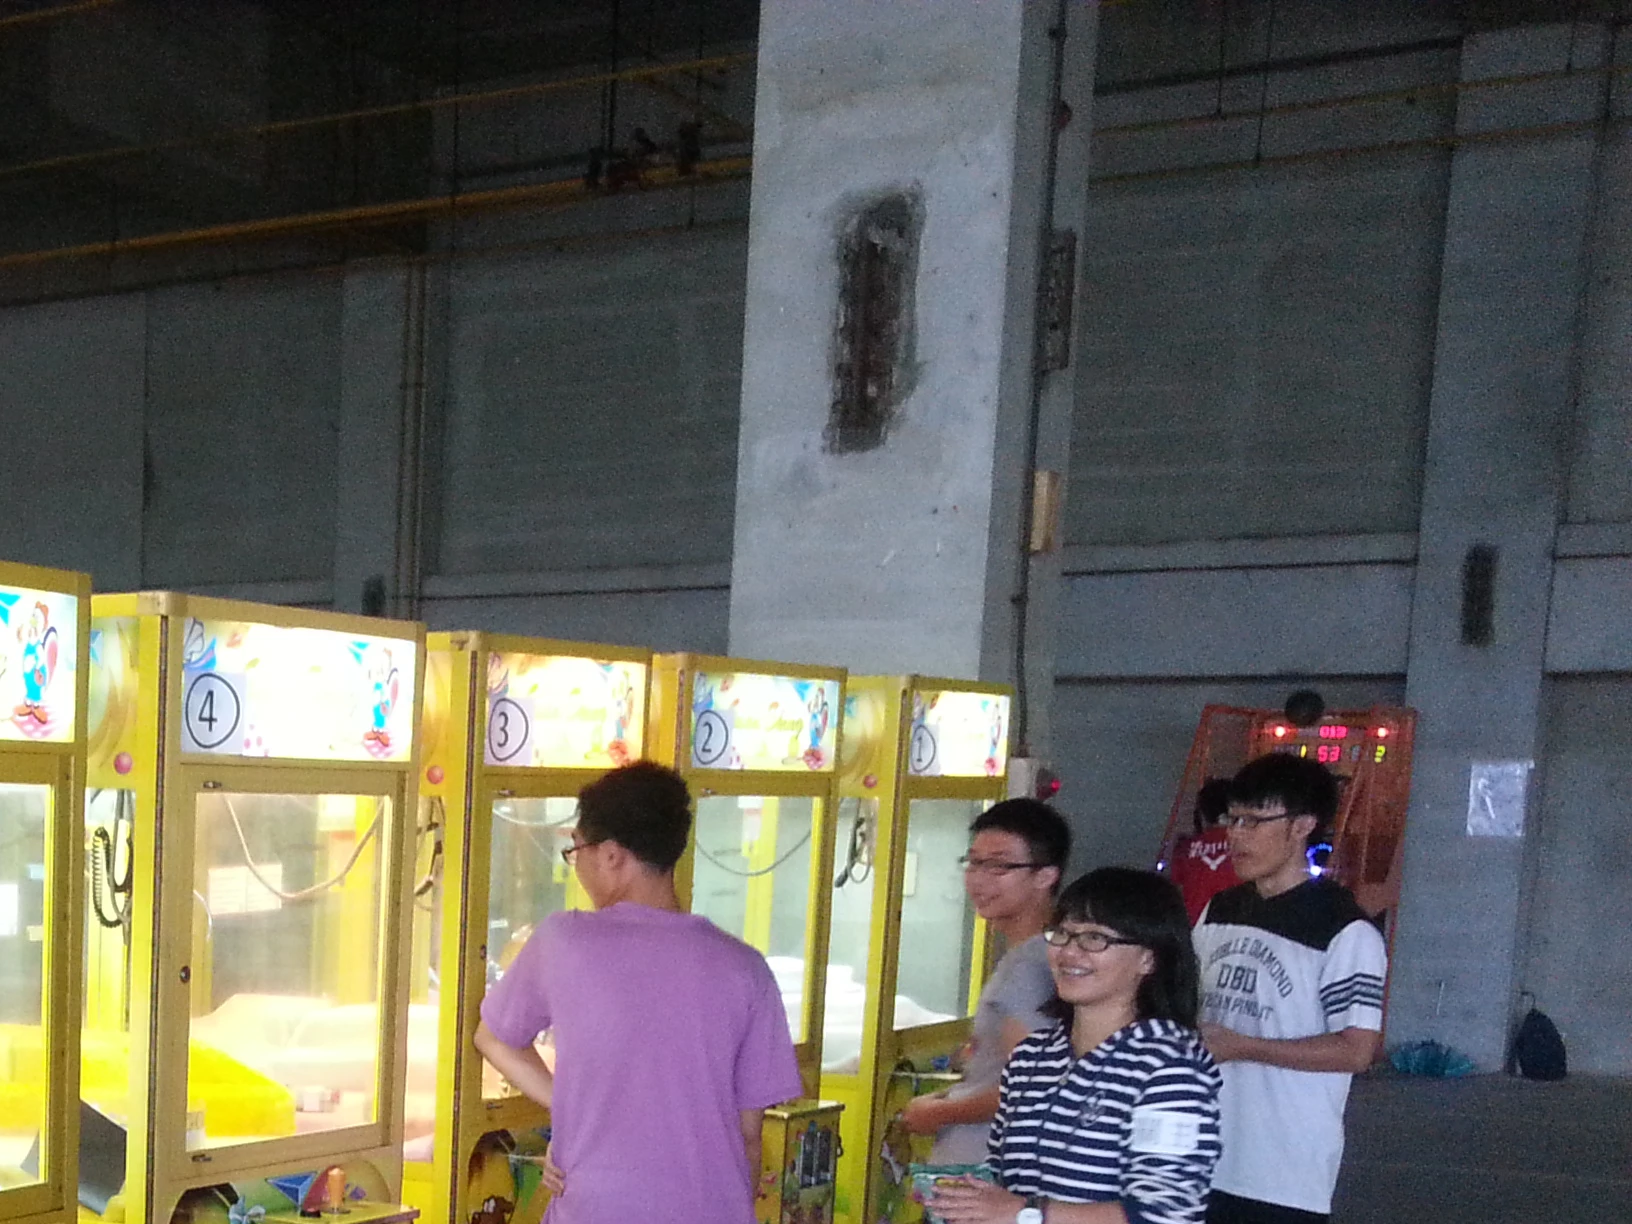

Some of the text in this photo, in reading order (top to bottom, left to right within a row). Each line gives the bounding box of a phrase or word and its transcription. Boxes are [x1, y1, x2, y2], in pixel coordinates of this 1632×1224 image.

[198, 690, 218, 732] 4
[495, 712, 509, 748] 3
[702, 720, 714, 751] 2
[917, 731, 926, 761] 1
